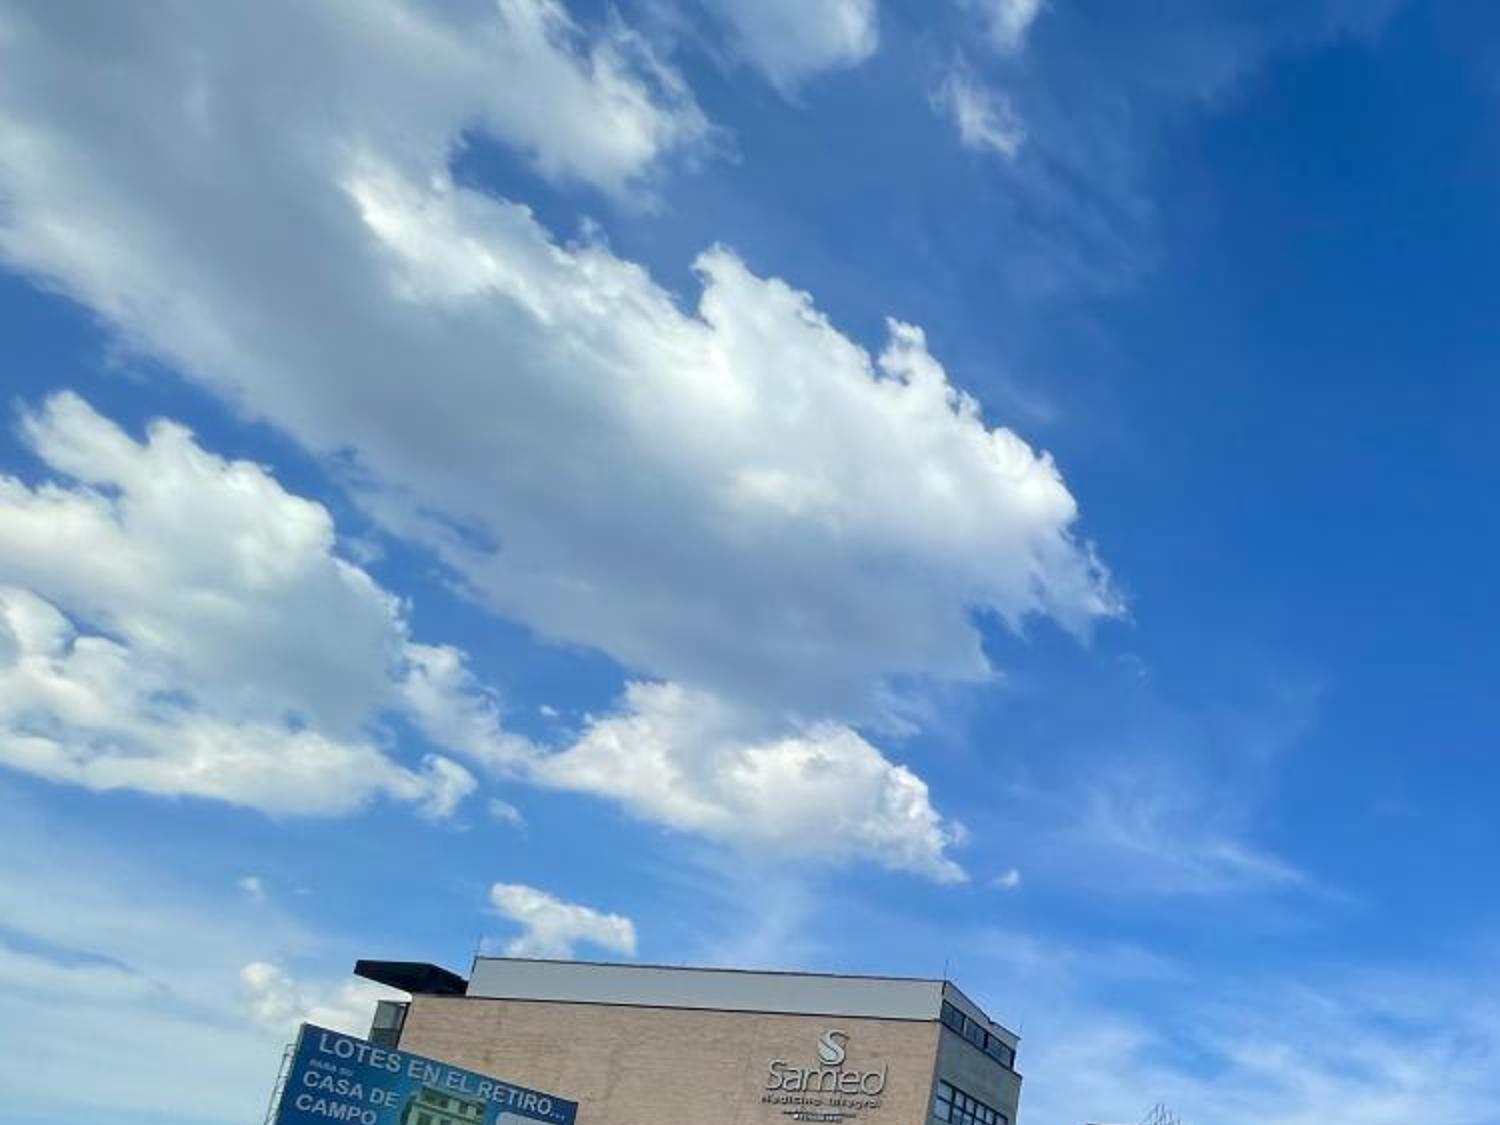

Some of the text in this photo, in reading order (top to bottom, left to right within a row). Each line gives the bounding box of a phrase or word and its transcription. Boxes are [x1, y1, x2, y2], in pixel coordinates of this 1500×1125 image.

[303, 1071, 400, 1108] CASA DE
[319, 1033, 565, 1121] LOTES EN EL RETIRO...
[766, 1058, 888, 1096] Samed
[295, 1094, 377, 1125] CAMPO
